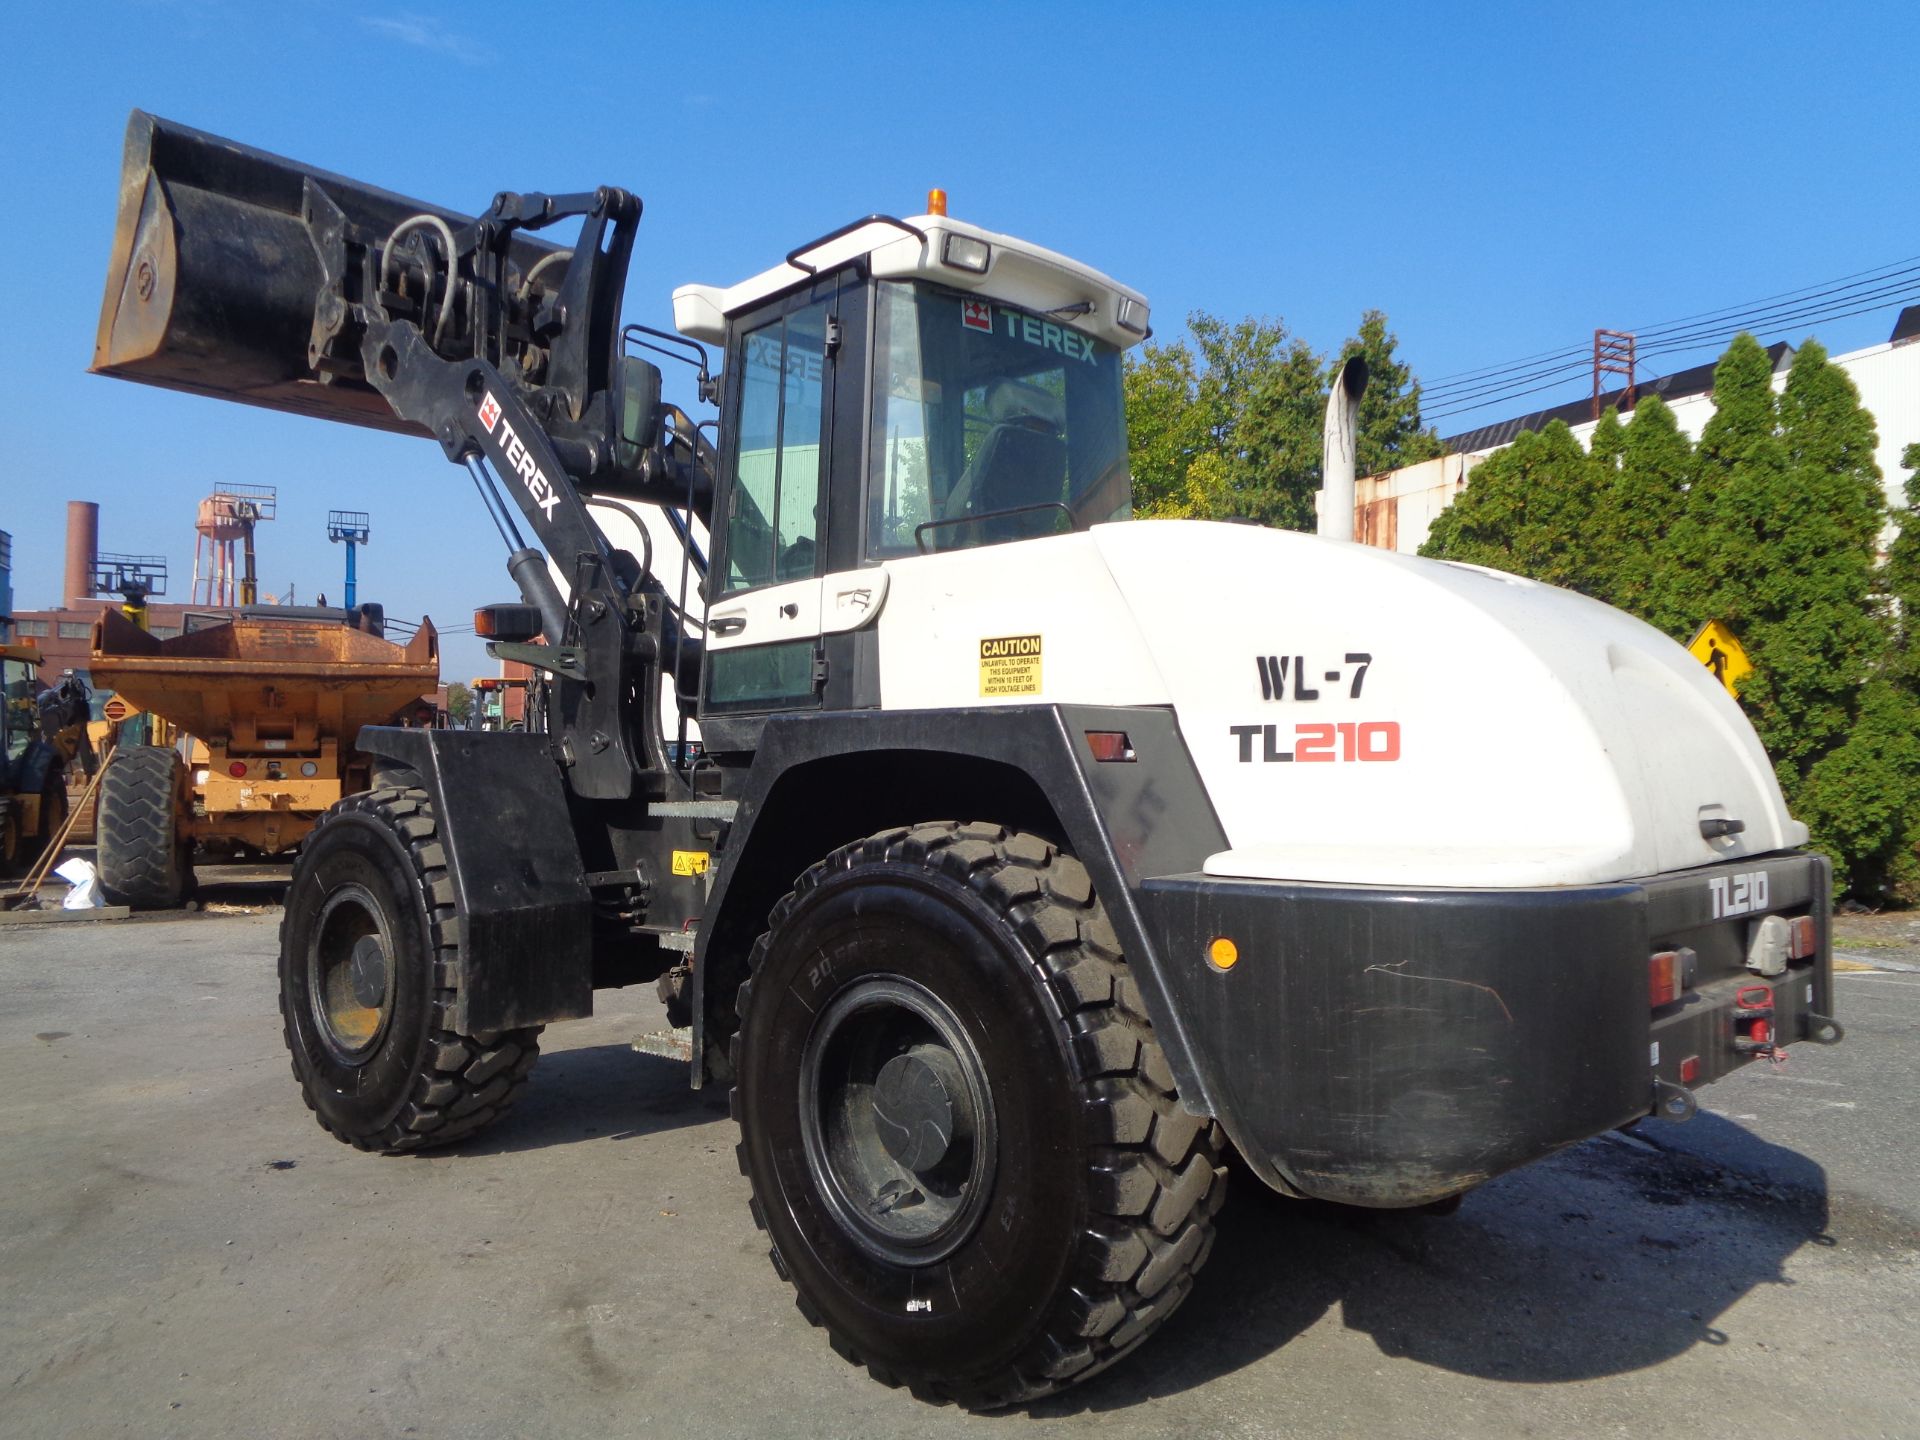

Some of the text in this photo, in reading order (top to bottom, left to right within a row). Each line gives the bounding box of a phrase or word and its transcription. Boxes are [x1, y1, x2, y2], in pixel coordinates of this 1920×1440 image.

[1000, 308, 1098, 367] TEREX
[499, 417, 561, 523] TEREX
[982, 638, 1040, 656] CAUTION
[982, 657, 1040, 668] UNLAWFUL TO OPERATE
[1002, 666, 1031, 675] EQUIPMENT
[1256, 653, 1373, 701] WL-7
[985, 683, 1036, 694] HIGH VOLTAGE LINES
[1013, 675, 1025, 683] FEET
[1026, 675, 1033, 683] OF
[1230, 721, 1401, 763] TL210
[1709, 871, 1769, 920] TL210
